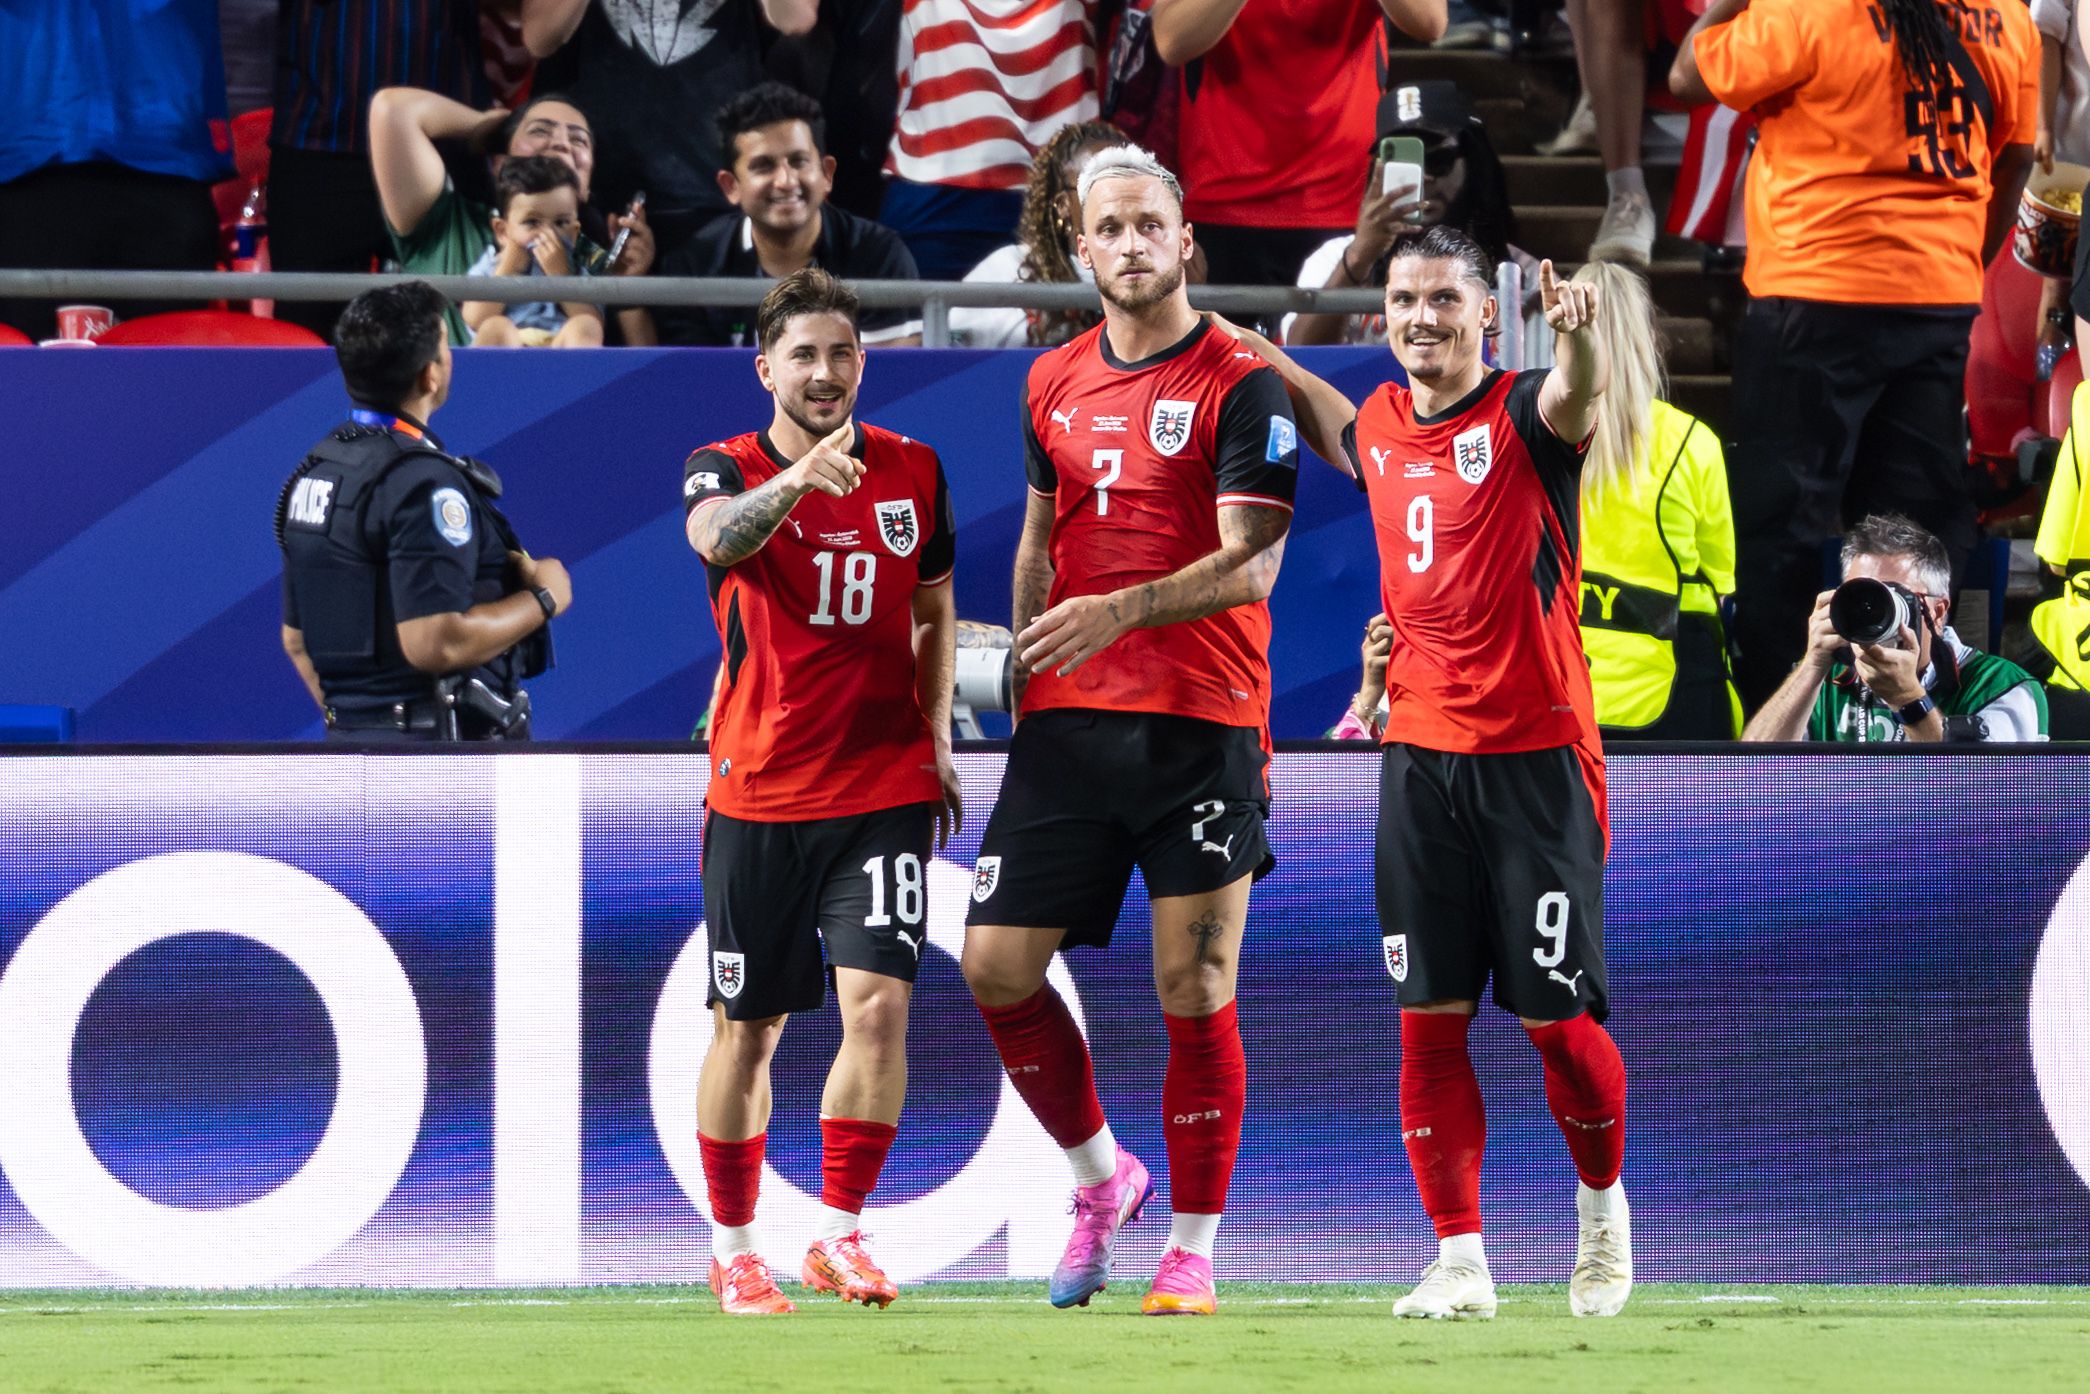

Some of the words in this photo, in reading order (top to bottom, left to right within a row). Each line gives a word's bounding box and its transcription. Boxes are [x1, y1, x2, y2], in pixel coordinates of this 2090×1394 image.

[1092, 449, 1124, 516] 7
[1407, 495, 1433, 573] 9
[809, 551, 877, 625] 18
[1192, 800, 1224, 841] 7
[862, 853, 922, 927] 18
[1533, 891, 1569, 967] 9
